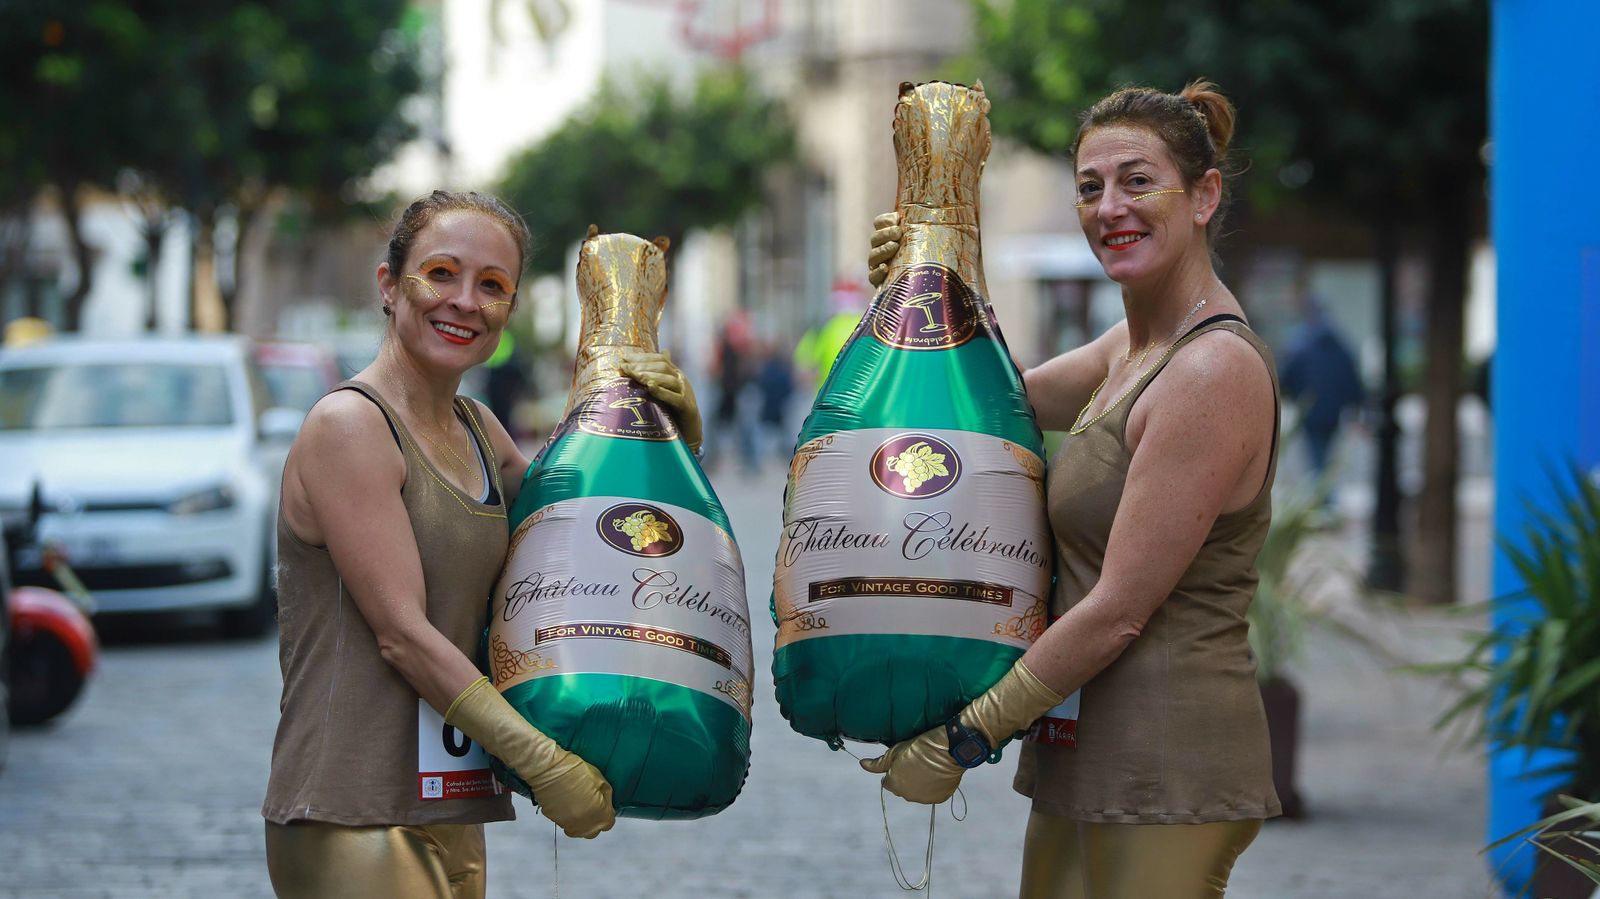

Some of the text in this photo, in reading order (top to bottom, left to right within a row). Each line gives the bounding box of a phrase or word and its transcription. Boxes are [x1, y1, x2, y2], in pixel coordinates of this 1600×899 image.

[784, 512, 1048, 568] Château Célébration
[503, 572, 620, 622] Château
[819, 582, 1003, 600] FOR VINTAGE GOOD TIMES
[547, 625, 724, 660] FOR VINTAGE GOOD TIMES
